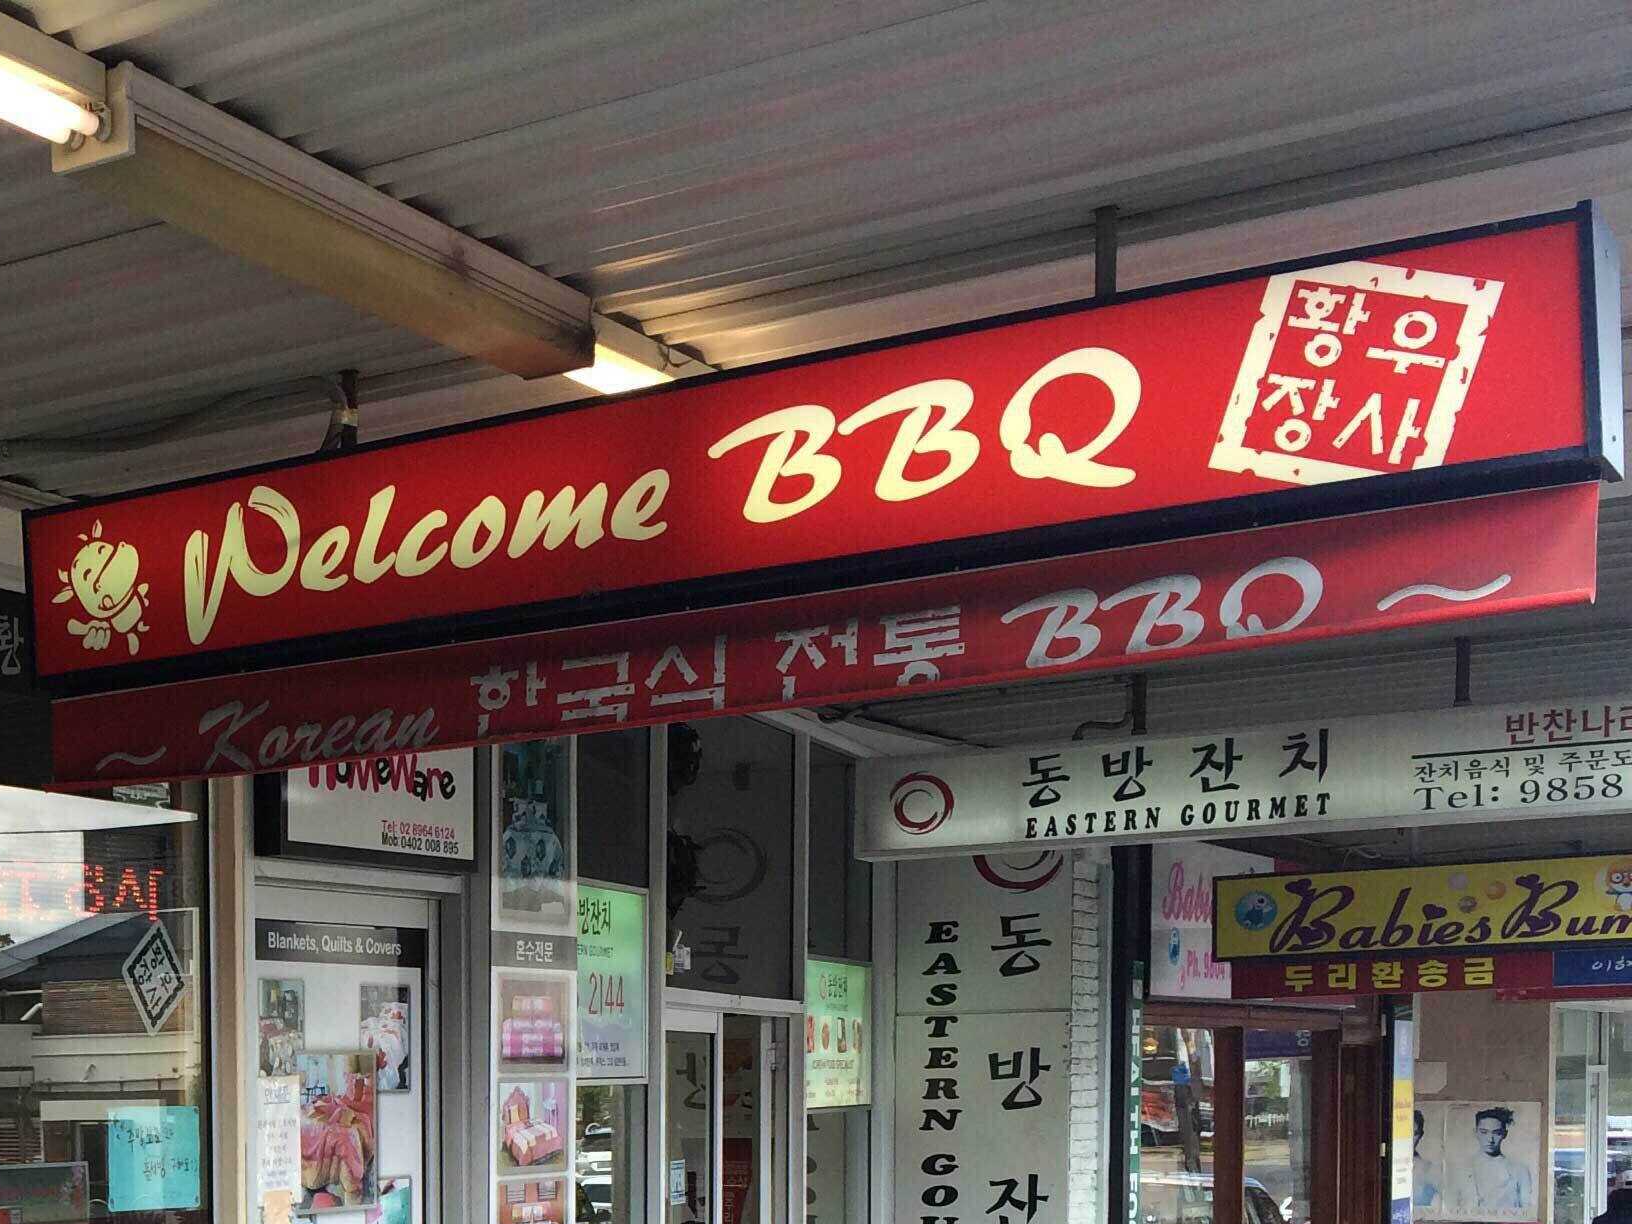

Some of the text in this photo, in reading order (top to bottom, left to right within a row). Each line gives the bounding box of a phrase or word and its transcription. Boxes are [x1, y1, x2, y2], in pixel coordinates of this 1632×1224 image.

[1286, 284, 1446, 376] 황우
[1260, 371, 1424, 468] 장사
[183, 345, 1143, 647] Welcome BBQ
[195, 556, 1324, 774] Korean 한국식 전통 BBQ
[1021, 727, 1331, 808] 동방잔치
[1414, 754, 1510, 784] 잔치음식
[1524, 753, 1545, 777] 및
[1025, 791, 1332, 839] EASTERN GOURMET
[1413, 774, 1624, 812] Tel: 9858
[399, 822, 410, 835] 02
[434, 825, 455, 840] 6124
[400, 835, 459, 855] 0402 008 895
[577, 897, 612, 936] 방잔치
[1268, 877, 1494, 954] Babies
[268, 931, 402, 957] Blankets, Quilts & Covers
[588, 971, 625, 1016] 2144
[1284, 957, 1497, 994] 두리환송금
[918, 920, 963, 1132] EASTERN
